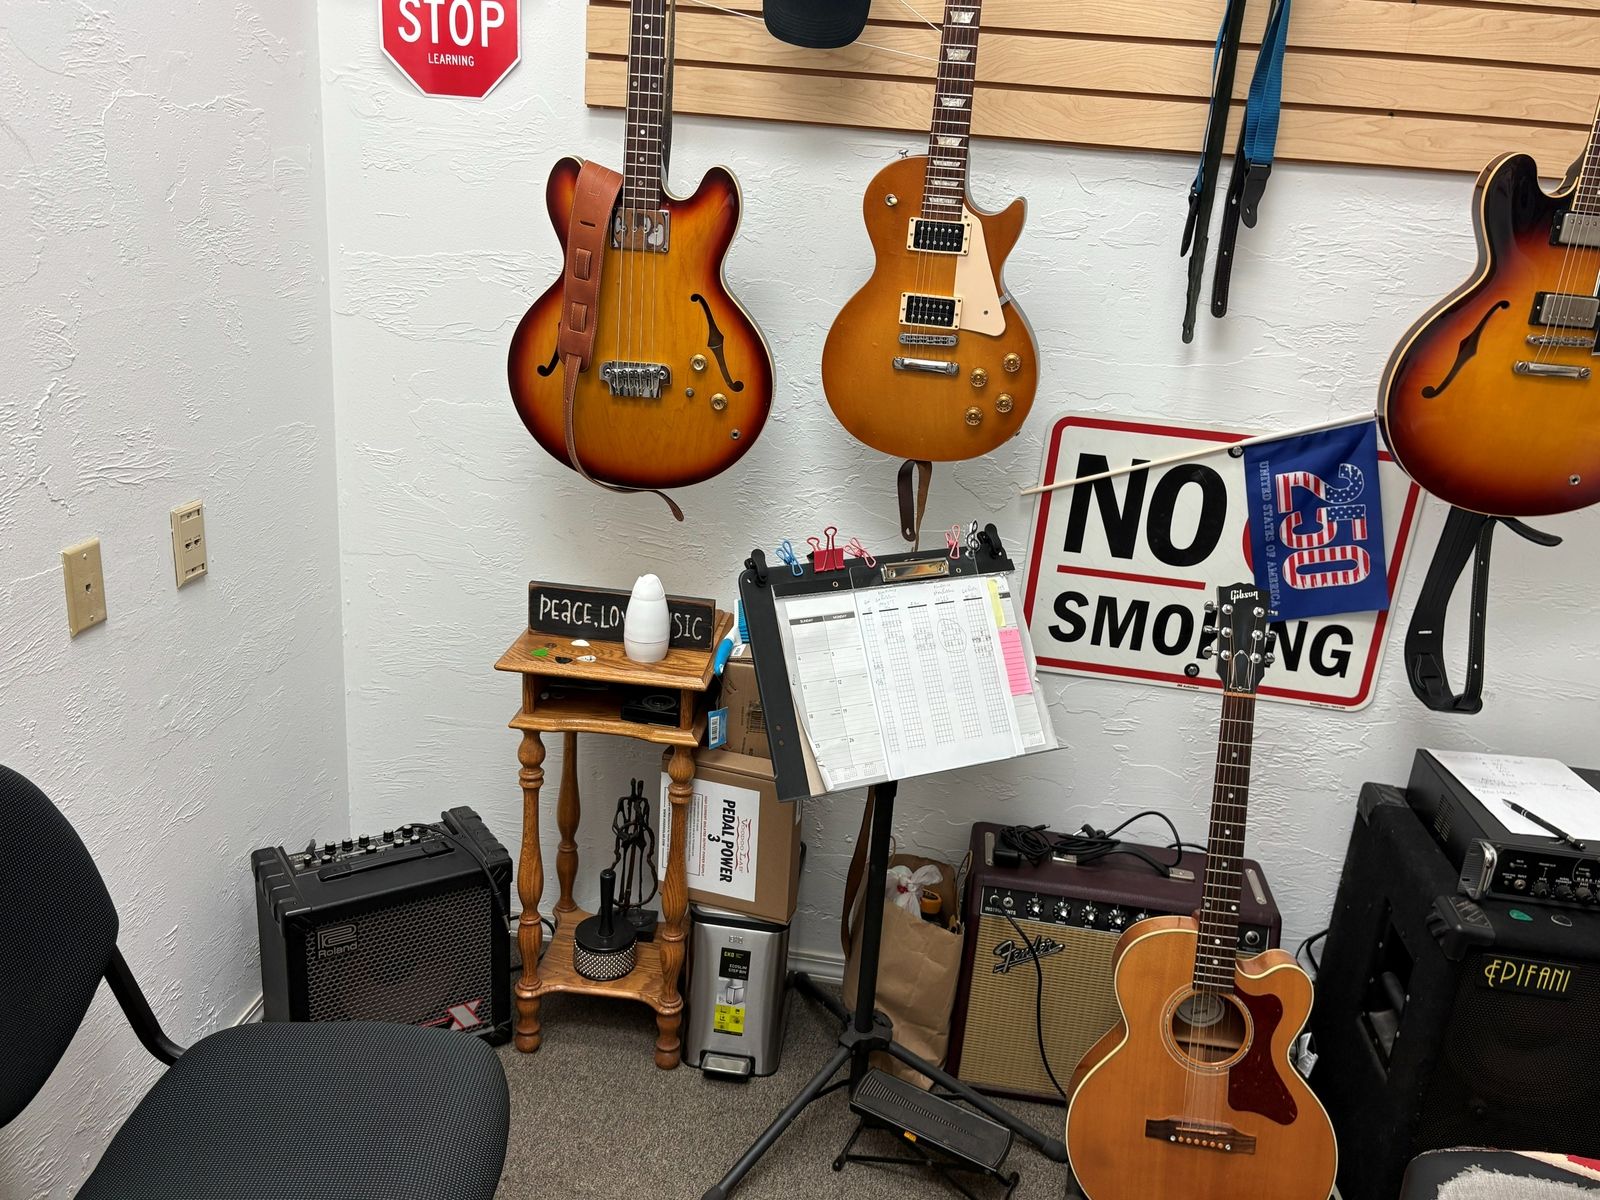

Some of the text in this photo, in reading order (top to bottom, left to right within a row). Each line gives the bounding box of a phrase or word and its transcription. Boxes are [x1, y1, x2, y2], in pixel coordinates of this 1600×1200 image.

[397, 0, 505, 48] STOP
[428, 52, 475, 67] LEARNING
[1259, 460, 1271, 501] UNITED
[1063, 453, 1228, 567] NO
[1263, 504, 1274, 542] STATES
[1275, 463, 1371, 590] 250
[1266, 544, 1276, 558] OF
[1230, 589, 1259, 604] Gibson
[1267, 561, 1281, 608] AMERICA
[707, 834, 720, 842] 3
[720, 799, 736, 883] PEDAL POWER
[318, 941, 358, 959] Roland
[993, 935, 1065, 974] Fender
[1484, 959, 1572, 994] EPIFANI
